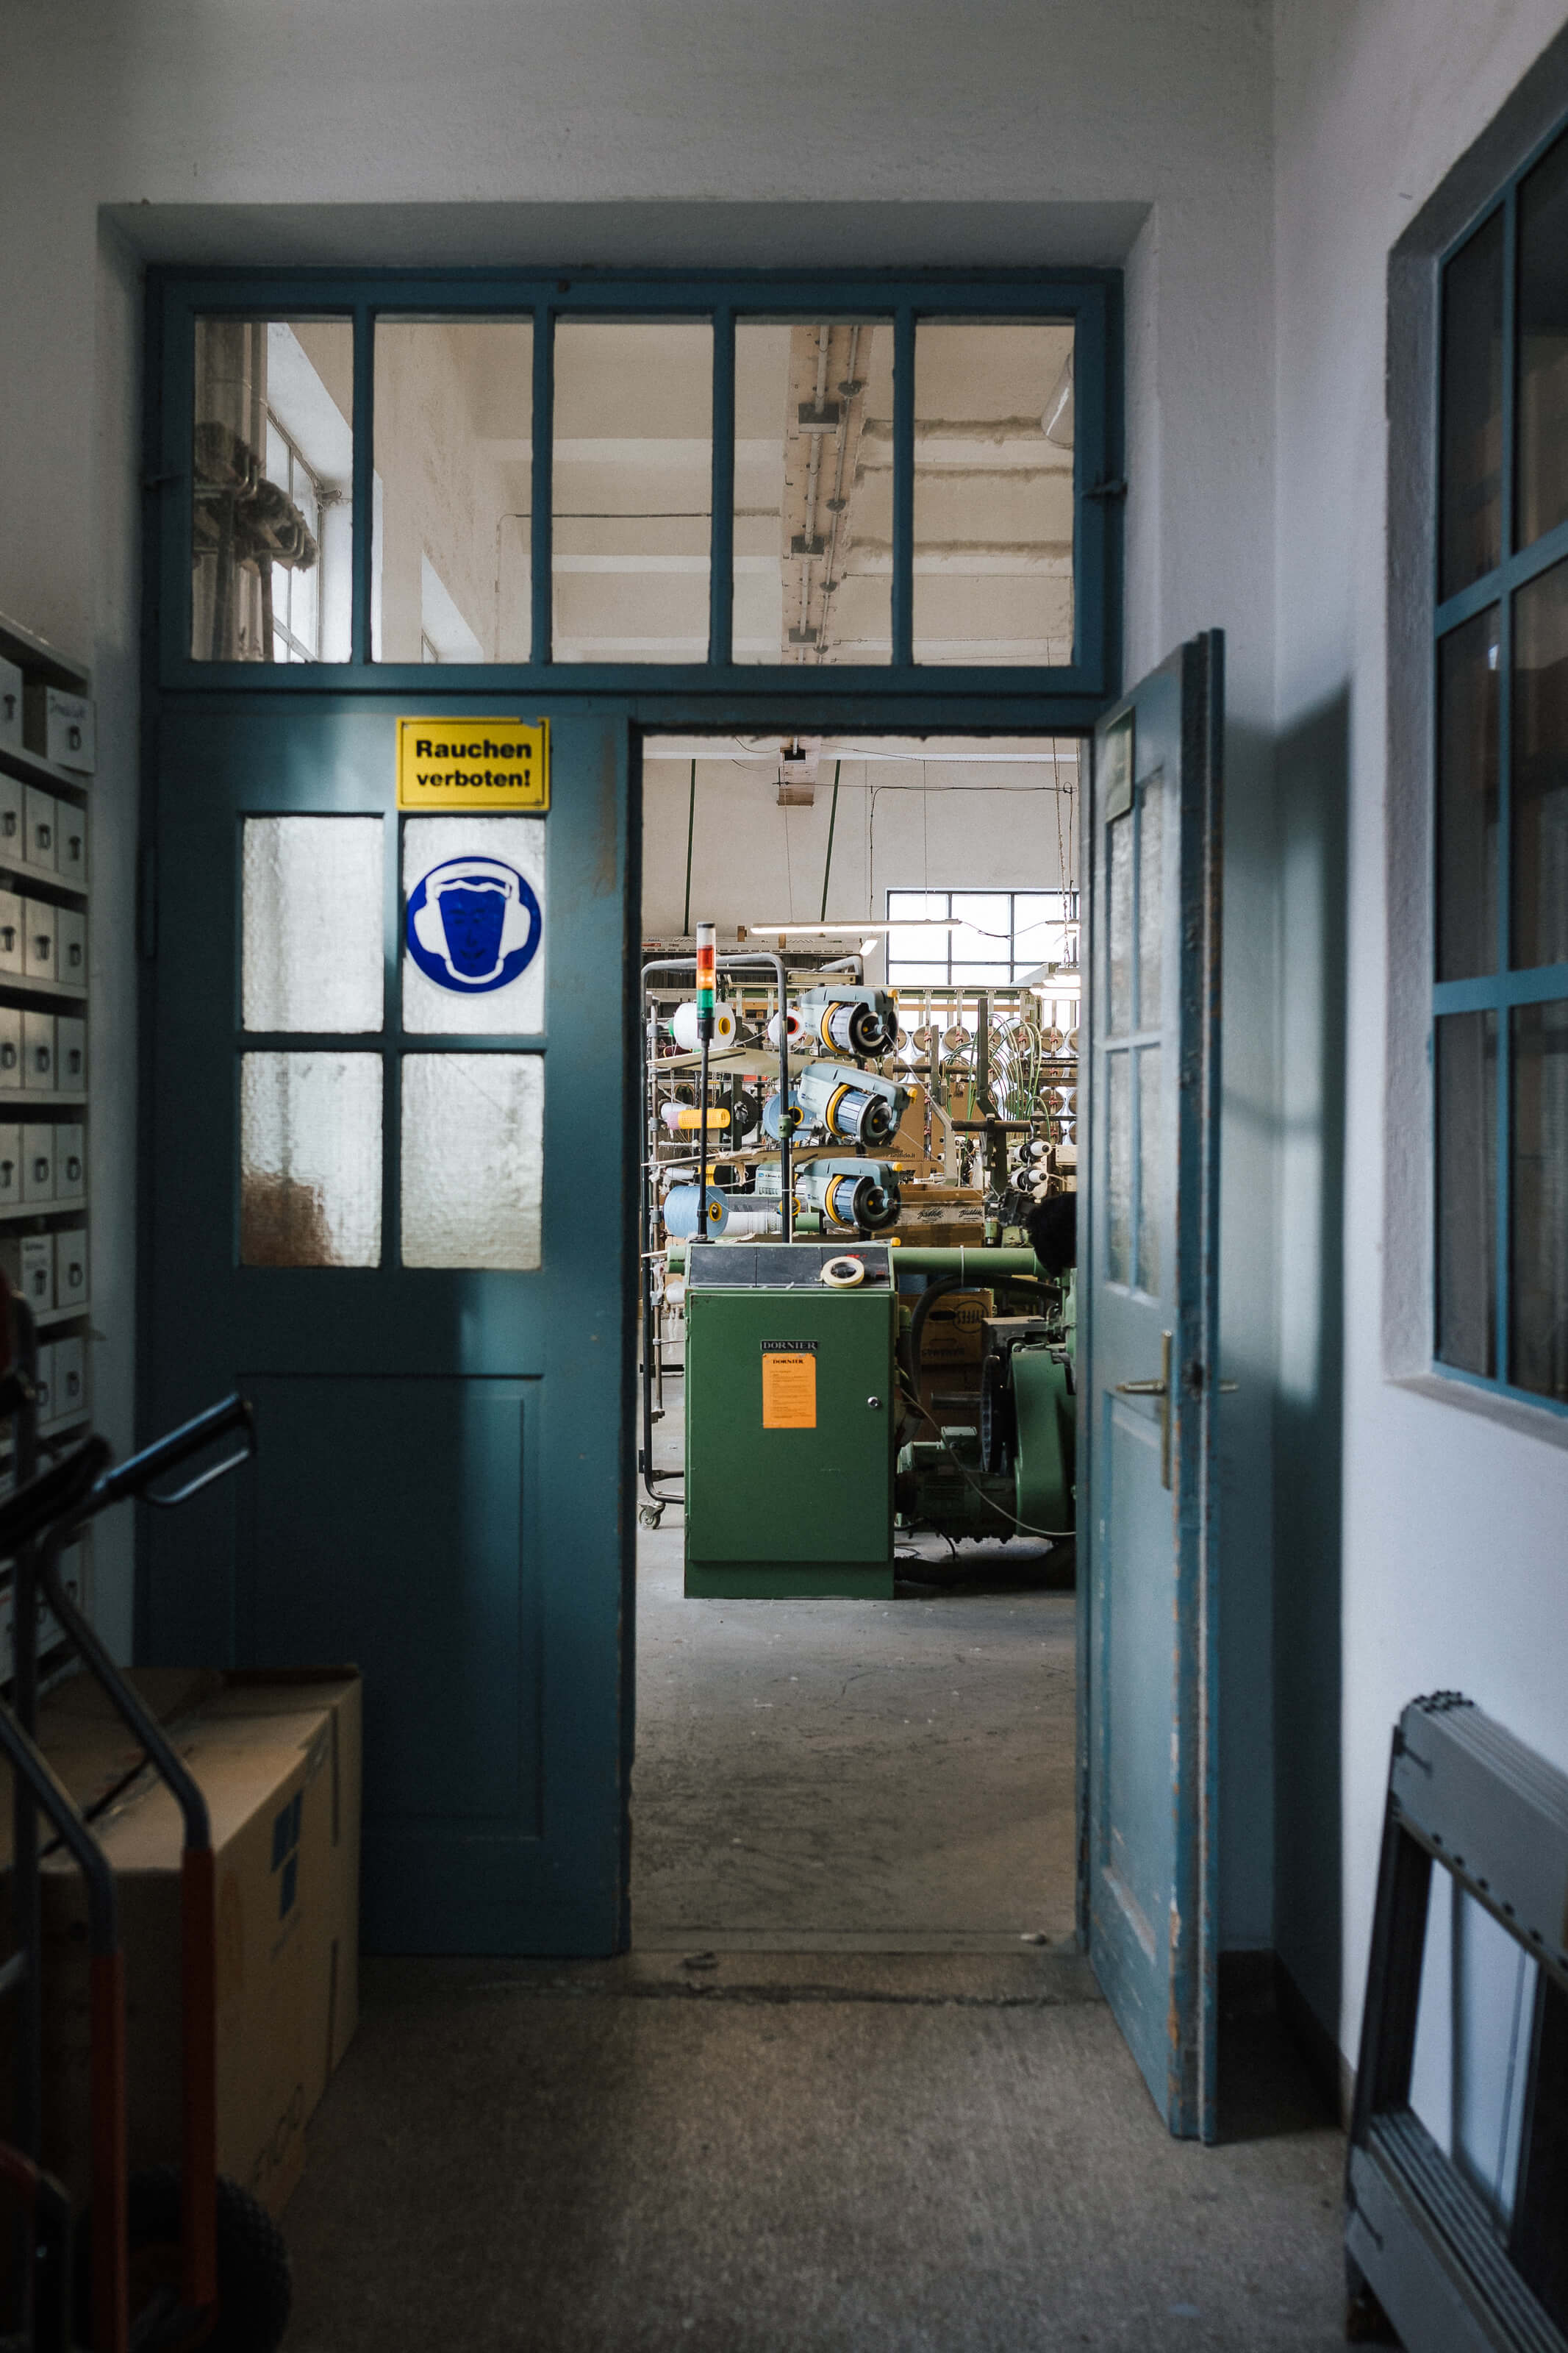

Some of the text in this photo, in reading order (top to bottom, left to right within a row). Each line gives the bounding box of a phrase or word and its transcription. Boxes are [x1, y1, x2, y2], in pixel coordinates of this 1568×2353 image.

[416, 740, 531, 759] Rauchen
[417, 770, 531, 787] verboten!
[763, 1341, 817, 1350] DORNIER
